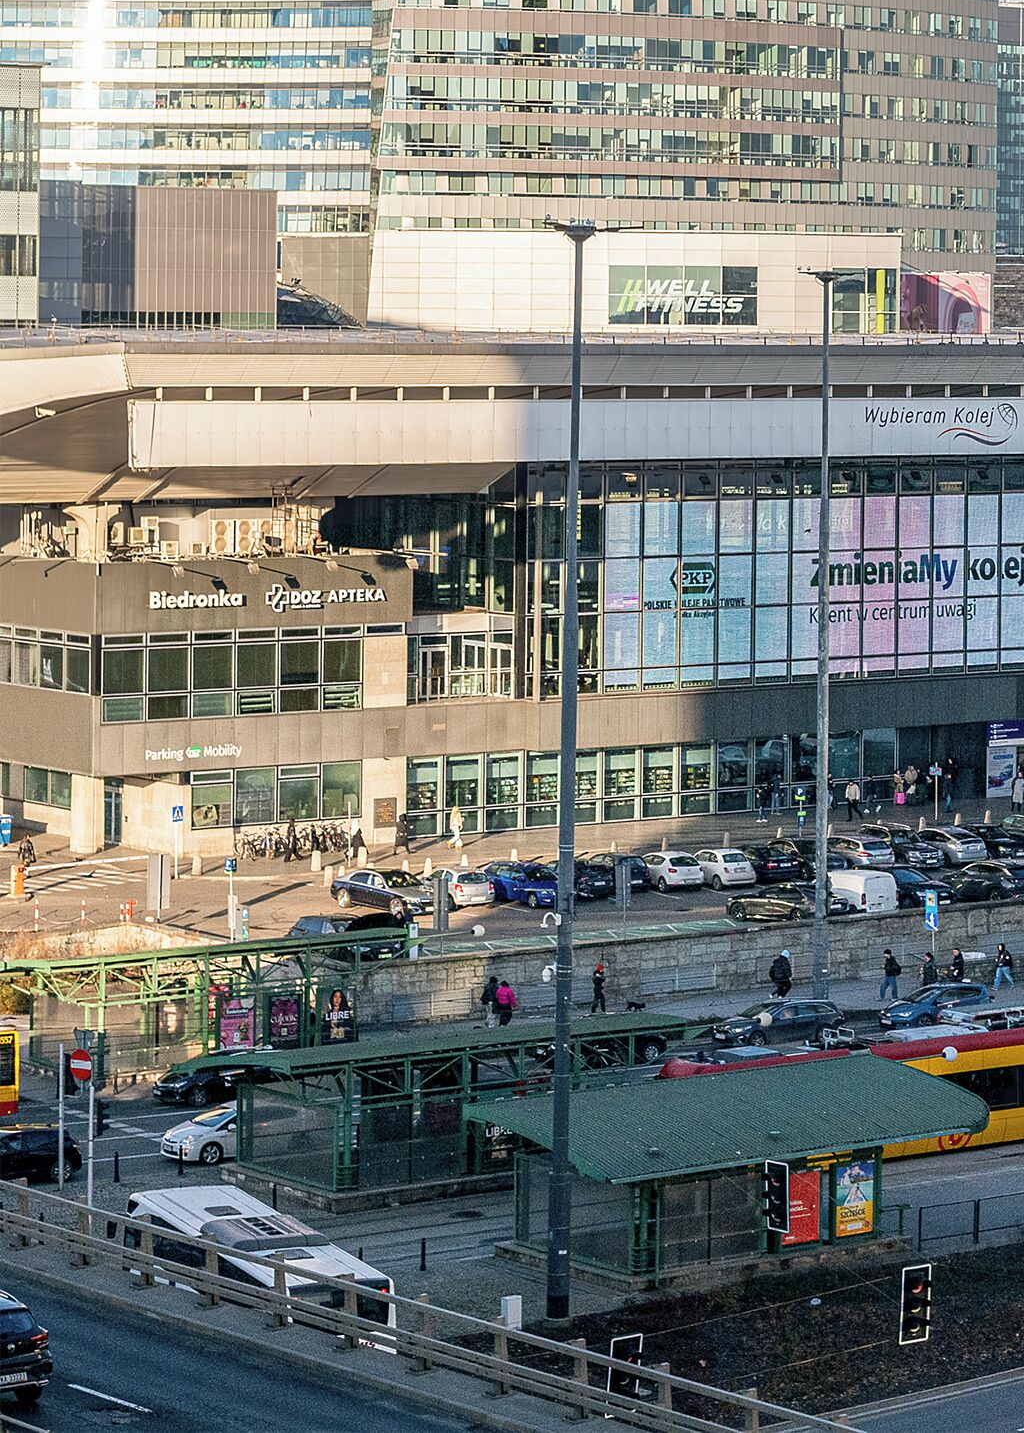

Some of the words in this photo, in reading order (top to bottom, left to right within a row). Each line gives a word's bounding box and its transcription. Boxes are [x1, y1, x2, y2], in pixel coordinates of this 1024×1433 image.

[646, 280, 715, 296] WELL
[635, 297, 745, 313] FITNESS
[865, 407, 946, 427] Wybieram
[953, 407, 995, 427] Kolej
[681, 572, 713, 585] PKP
[149, 590, 244, 609] Biedronka
[290, 590, 322, 604] DOZ
[328, 588, 386, 602] APTEKA
[644, 600, 672, 610] POLSKIE
[675, 599, 700, 608] LEJE
[702, 597, 746, 607] PATWOWE
[809, 607, 852, 623] Kent
[856, 608, 868, 622] w
[872, 604, 931, 621] centrum
[936, 599, 977, 621] uwagi
[145, 747, 184, 761] Parking
[203, 743, 242, 758] Mobility
[325, 1010, 350, 1021] LIBRE
